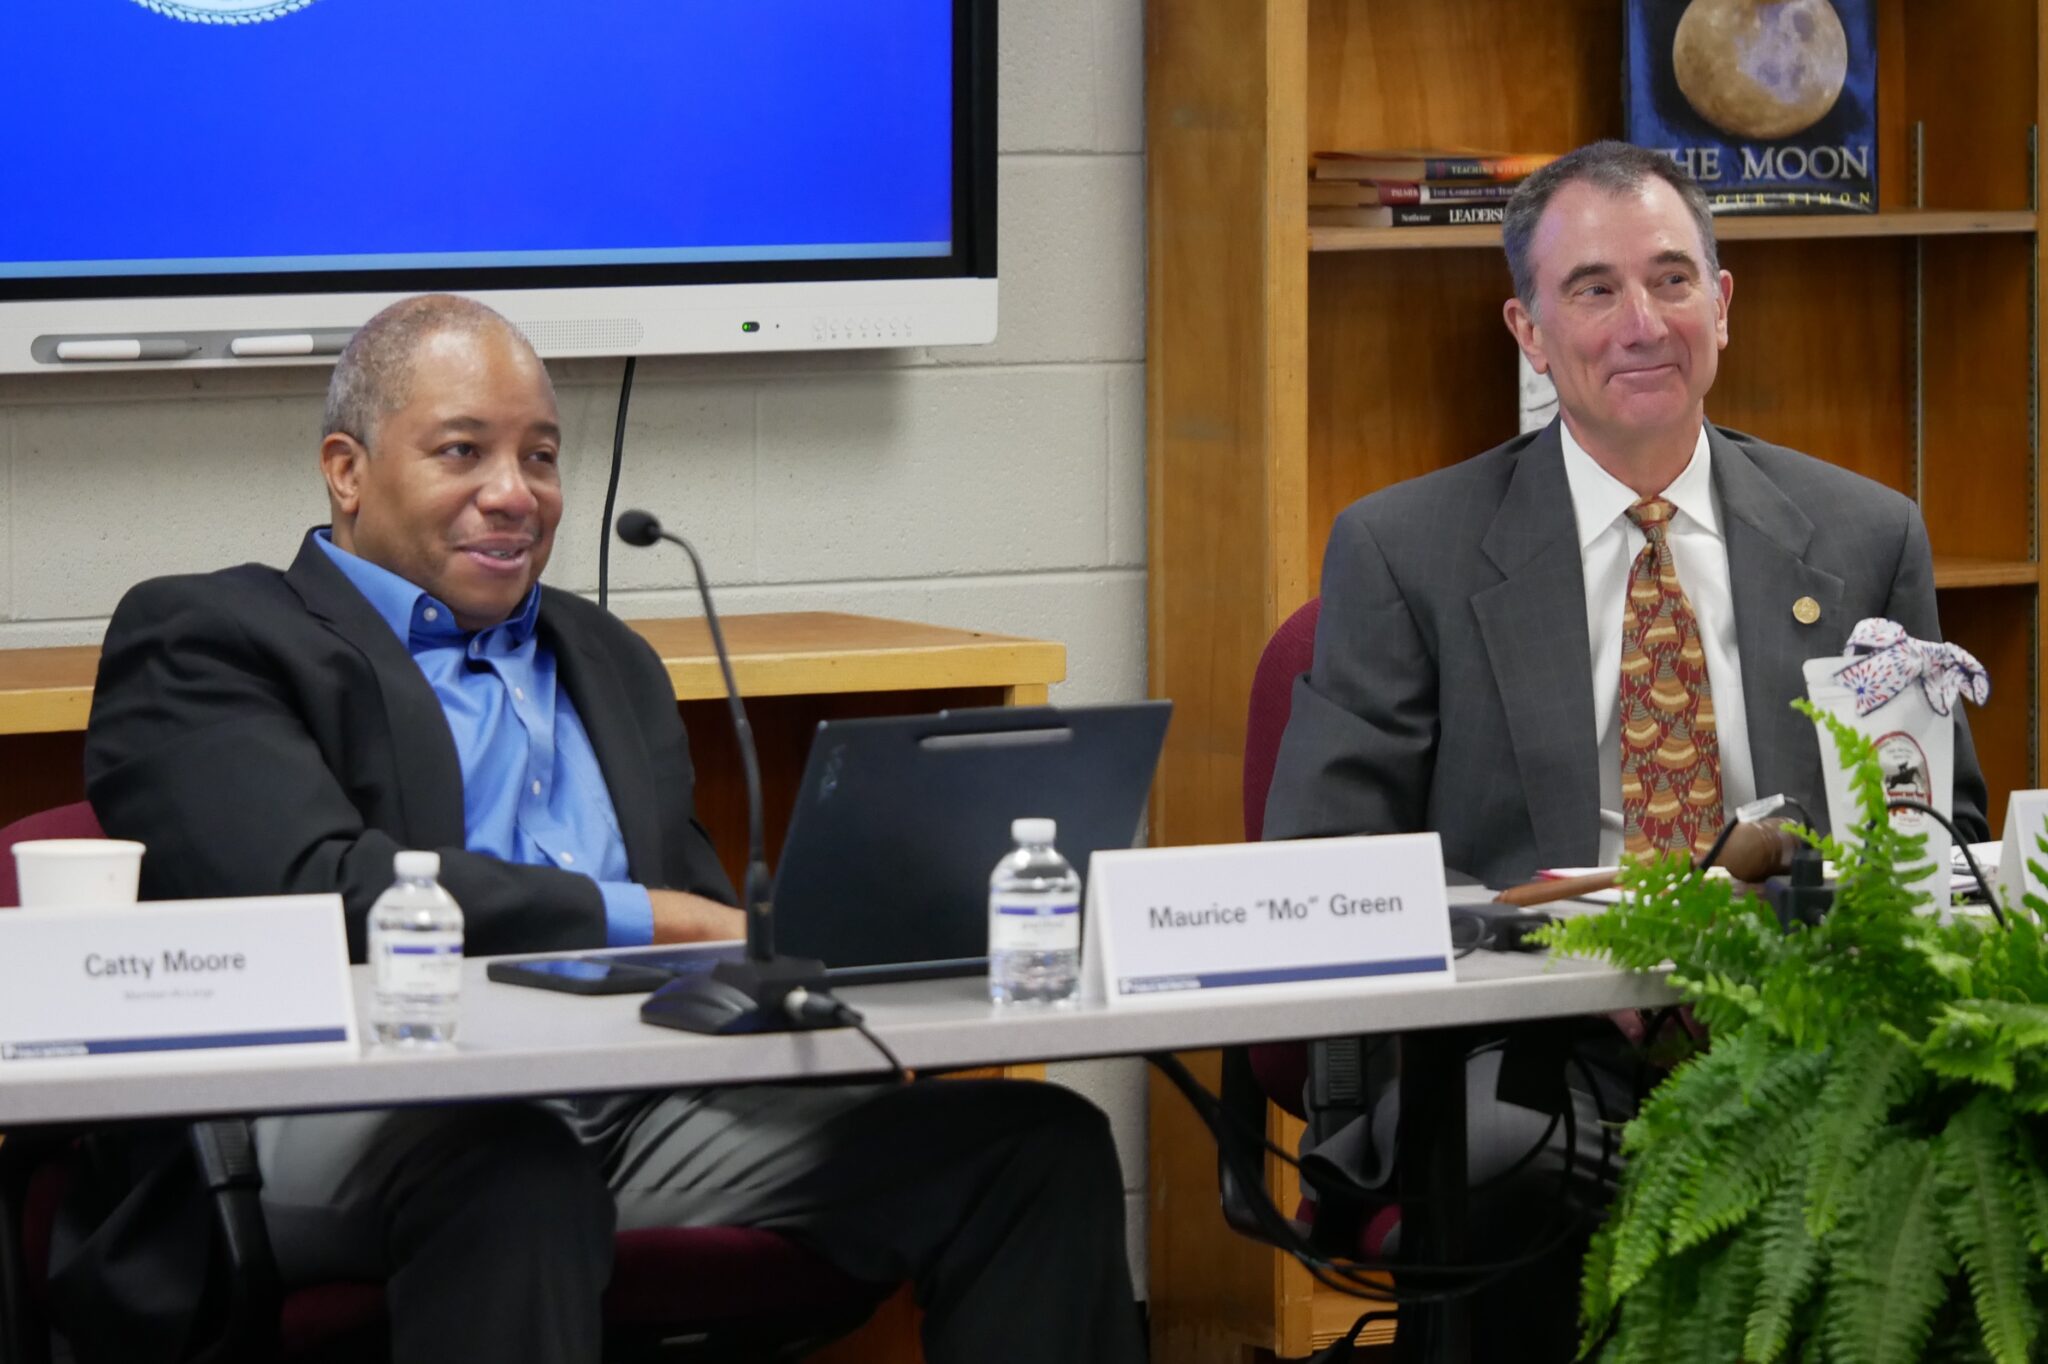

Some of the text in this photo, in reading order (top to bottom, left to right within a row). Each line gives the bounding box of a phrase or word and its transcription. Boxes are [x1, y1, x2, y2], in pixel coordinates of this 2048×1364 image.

[1742, 146, 1869, 180] MOON
[1788, 192, 1870, 205] SIMON
[1149, 903, 1246, 928] Maurice
[1330, 894, 1403, 917] Green
[85, 951, 246, 978] Catty Moore
